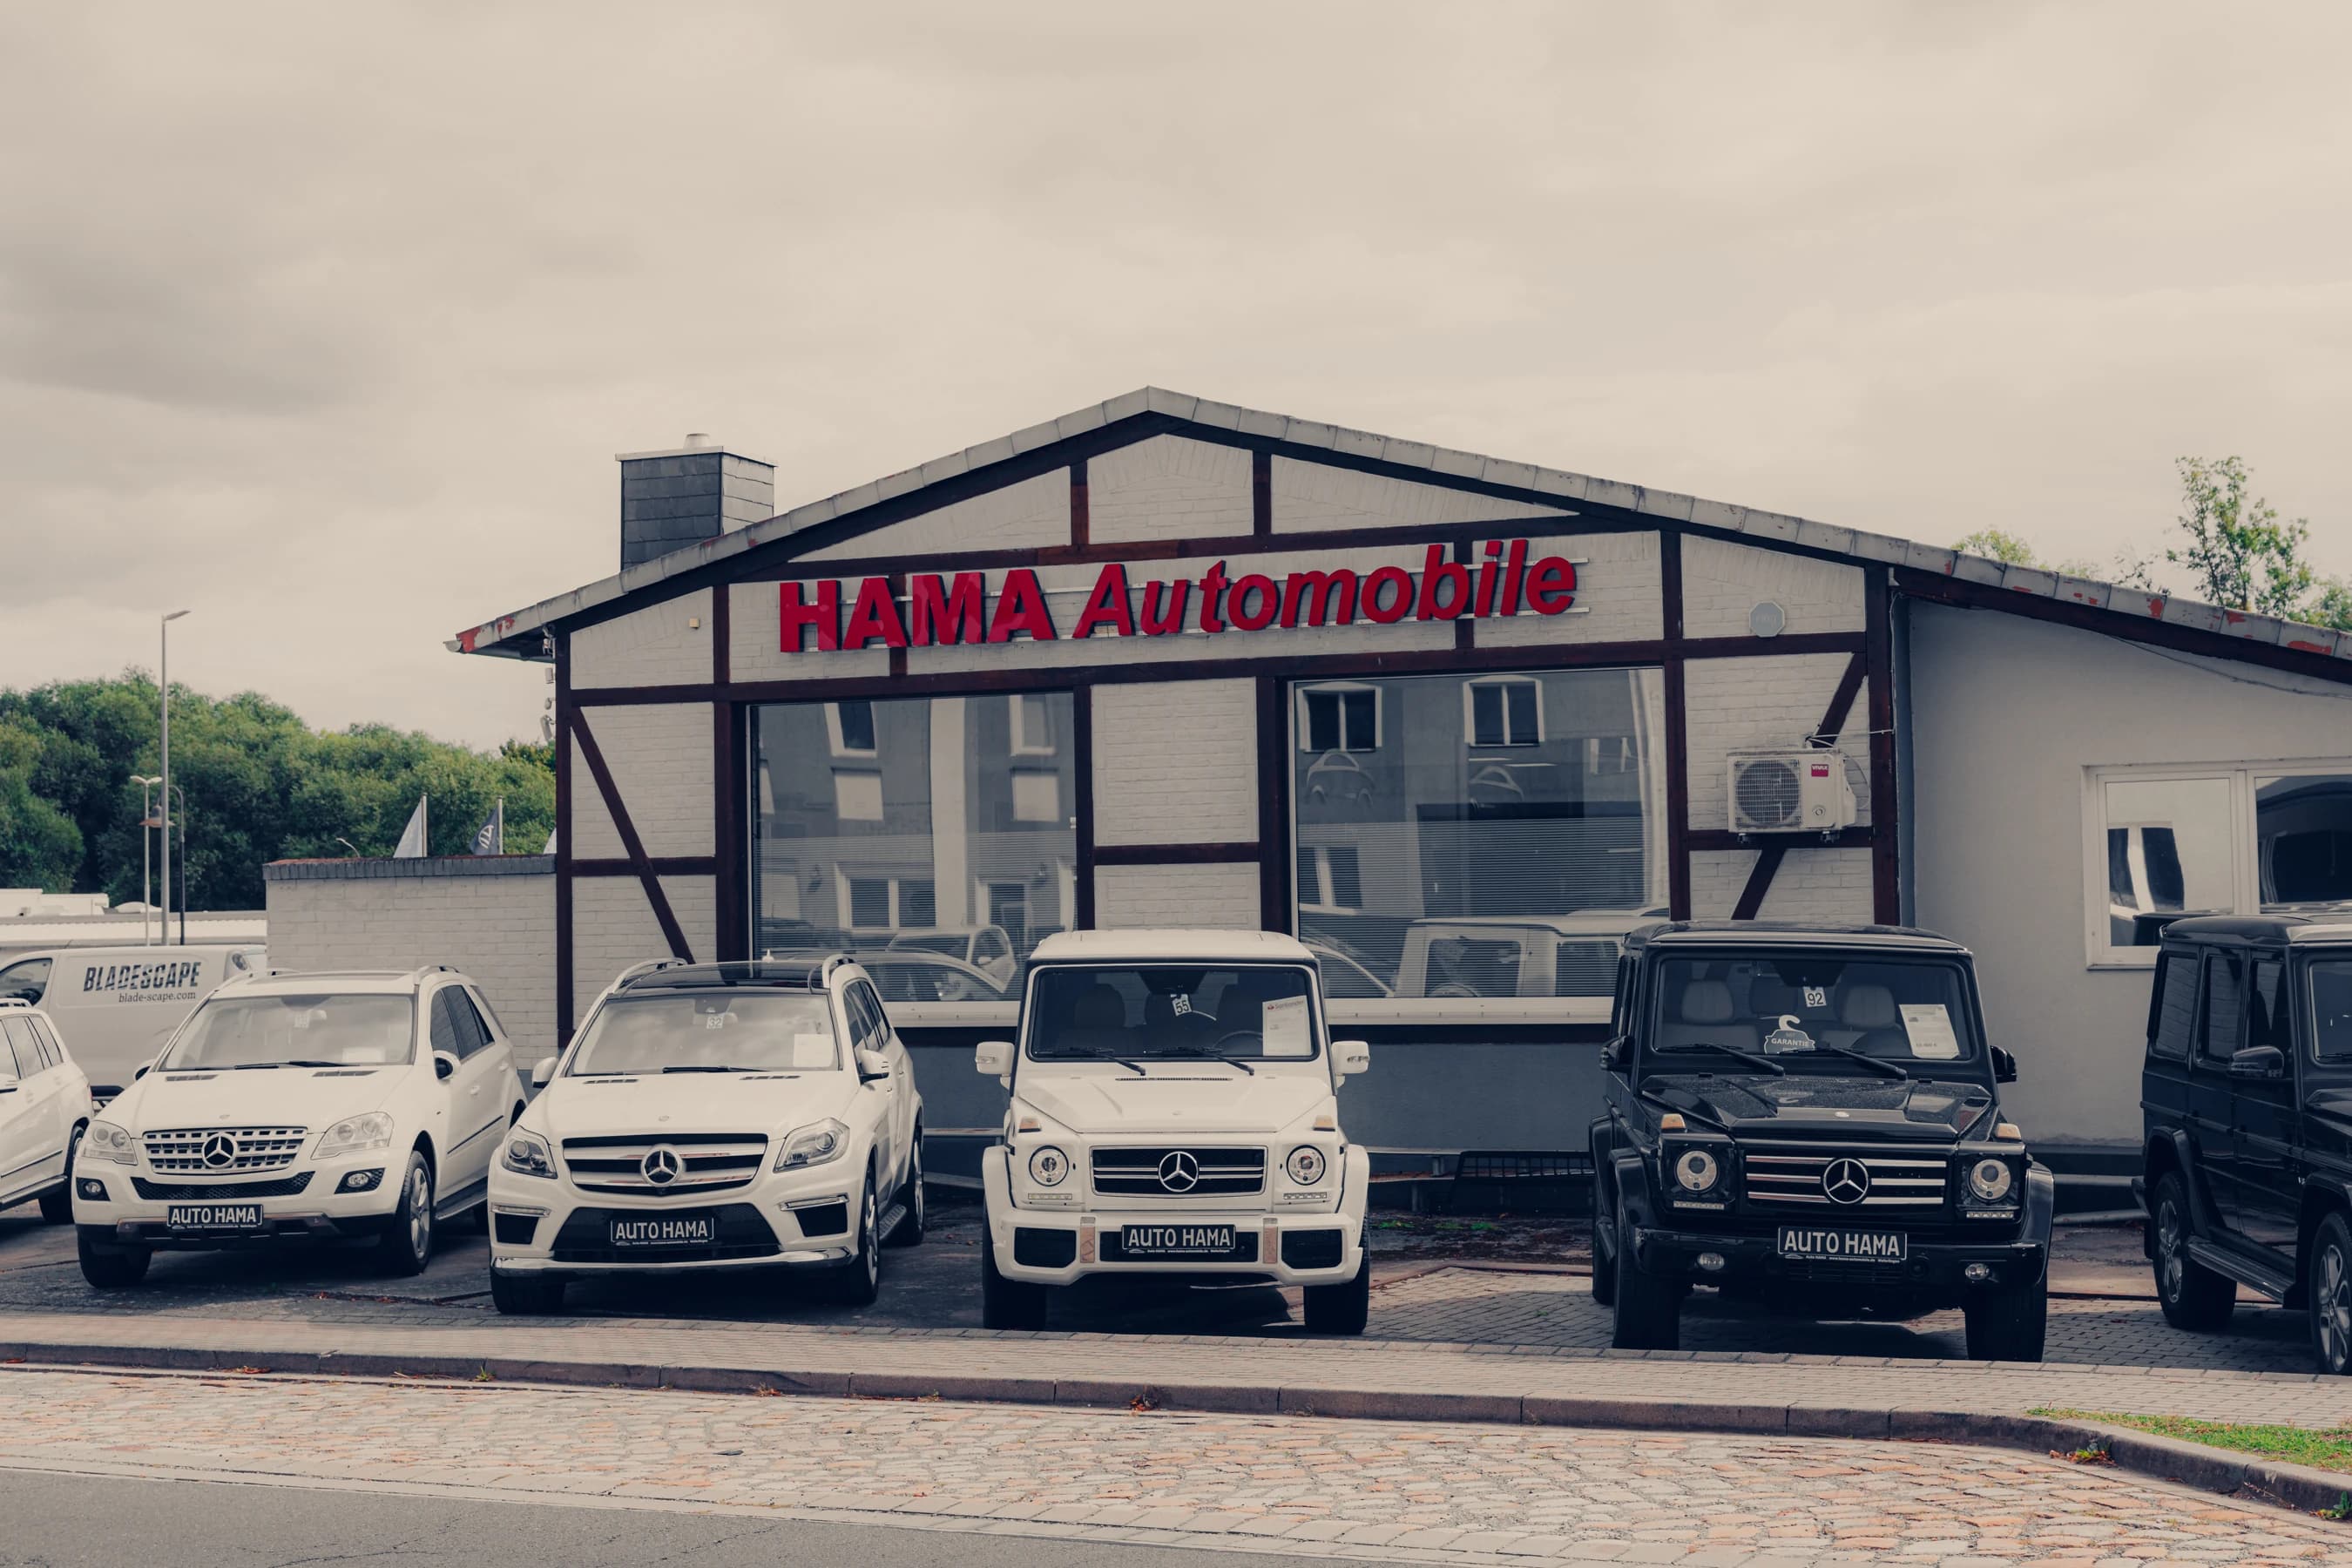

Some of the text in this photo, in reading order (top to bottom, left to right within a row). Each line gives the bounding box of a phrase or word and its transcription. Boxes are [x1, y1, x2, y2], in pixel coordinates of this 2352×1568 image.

[780, 538, 1577, 652] HAMA Automobile
[84, 962, 201, 991] BLADESCAPE
[118, 992, 196, 1003] blade-scape.com
[1176, 1000, 1189, 1013] 55
[1808, 992, 1823, 1005] 92
[710, 1017, 722, 1028] 32
[1771, 1037, 1810, 1047] GARANTIE
[171, 1206, 257, 1224] AUTO HAMA
[615, 1220, 708, 1240] AUTO HAMA
[1128, 1228, 1230, 1247] AUTO HAMA
[1784, 1230, 1900, 1256] AUTO HAMA
